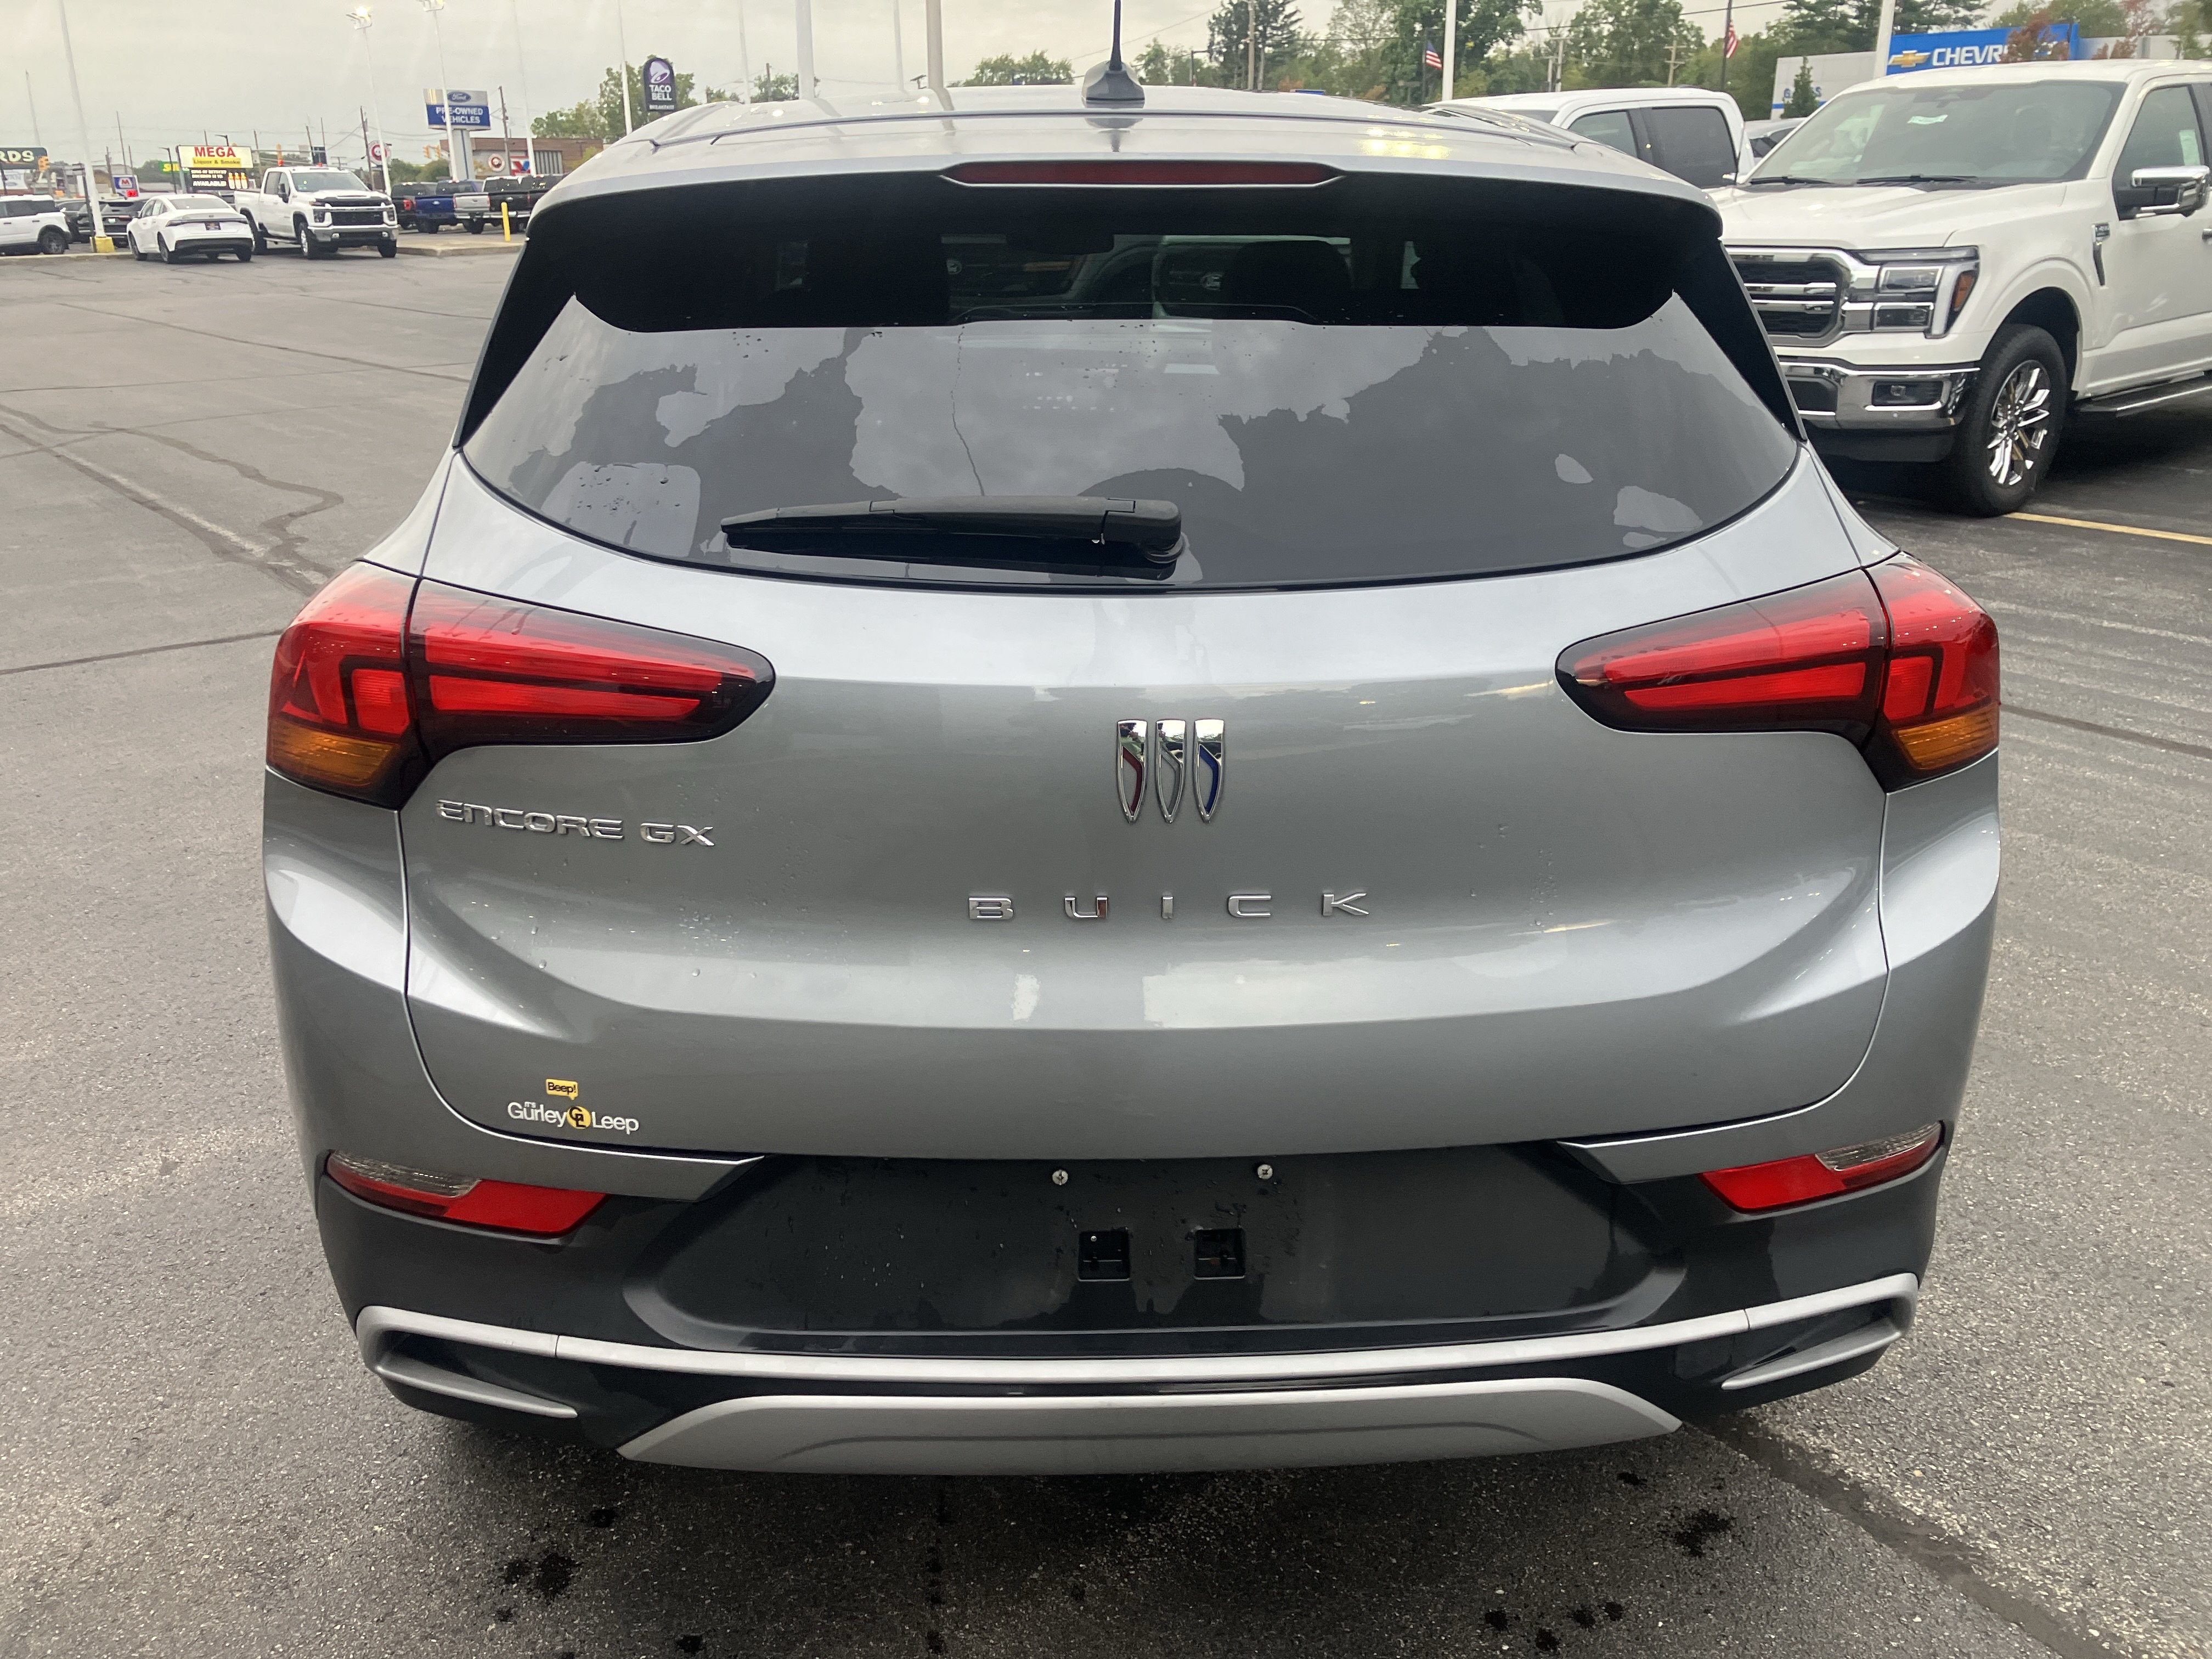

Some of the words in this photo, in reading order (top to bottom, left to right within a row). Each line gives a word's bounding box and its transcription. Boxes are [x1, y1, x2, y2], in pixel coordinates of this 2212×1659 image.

[1932, 41, 2033, 66] CHEVR
[649, 84, 672, 93] TACO
[651, 92, 673, 101] BELL
[441, 115, 481, 123] VHICLES
[194, 146, 236, 157] MEGA
[437, 799, 624, 839] ENCORE
[640, 822, 715, 847] GX
[968, 892, 1370, 919] BUICK
[548, 1082, 577, 1094] Beep!
[591, 1111, 640, 1135] Leep
